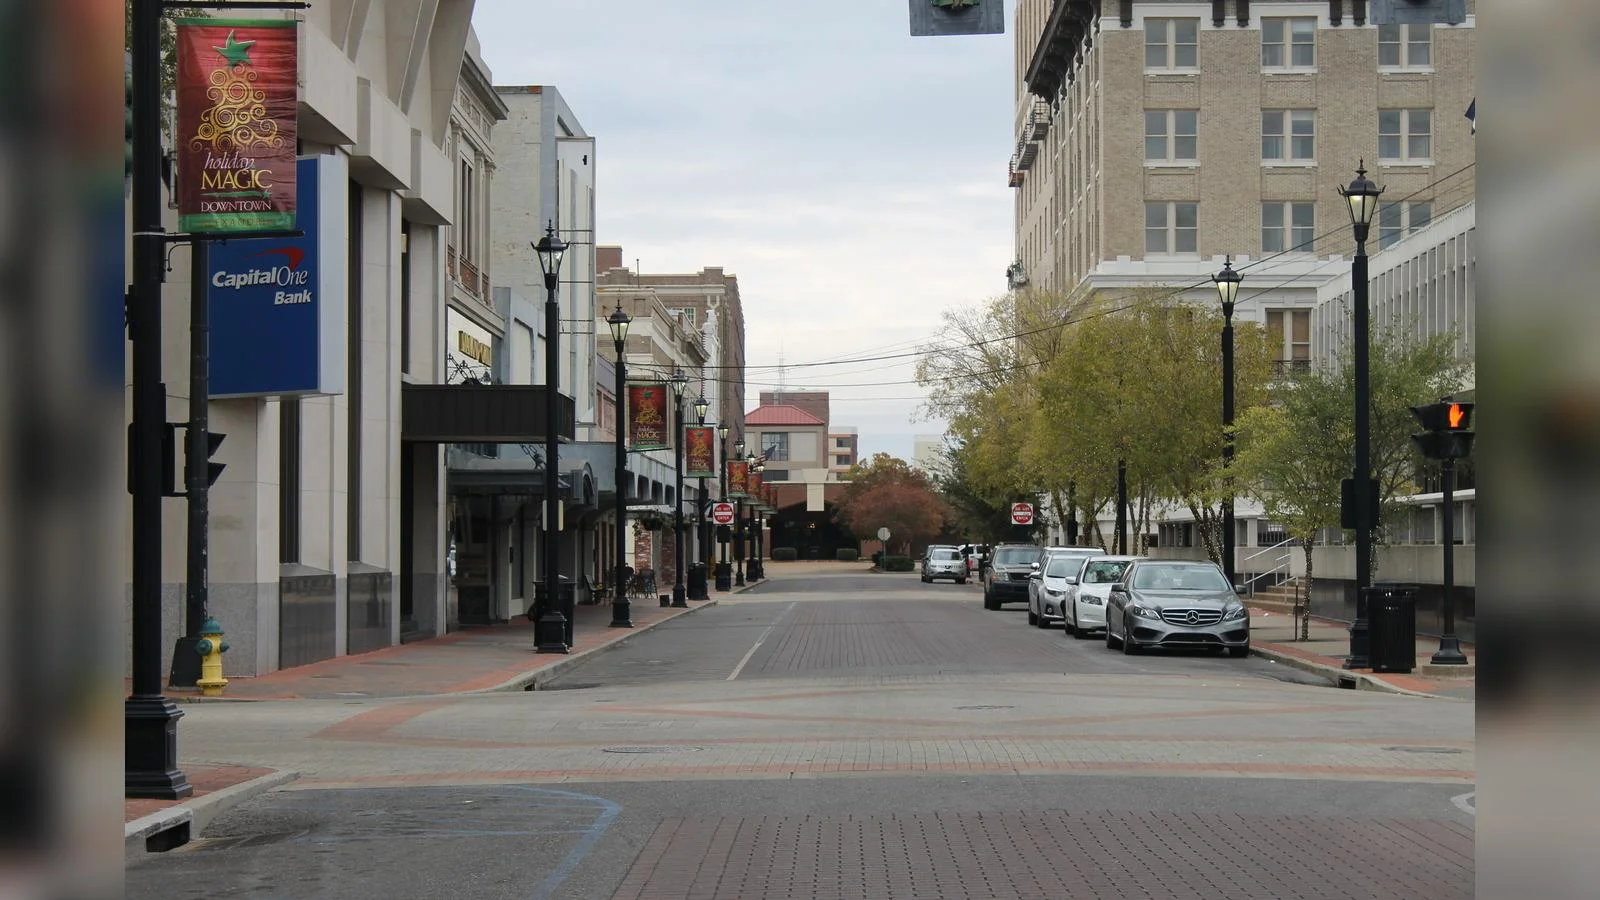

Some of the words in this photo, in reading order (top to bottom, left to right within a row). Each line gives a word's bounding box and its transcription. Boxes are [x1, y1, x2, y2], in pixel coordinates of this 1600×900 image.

[204, 151, 255, 171] holiday
[201, 169, 273, 189] MAGIC
[201, 200, 272, 212] DOWNTOWN
[274, 289, 312, 305] Bank
